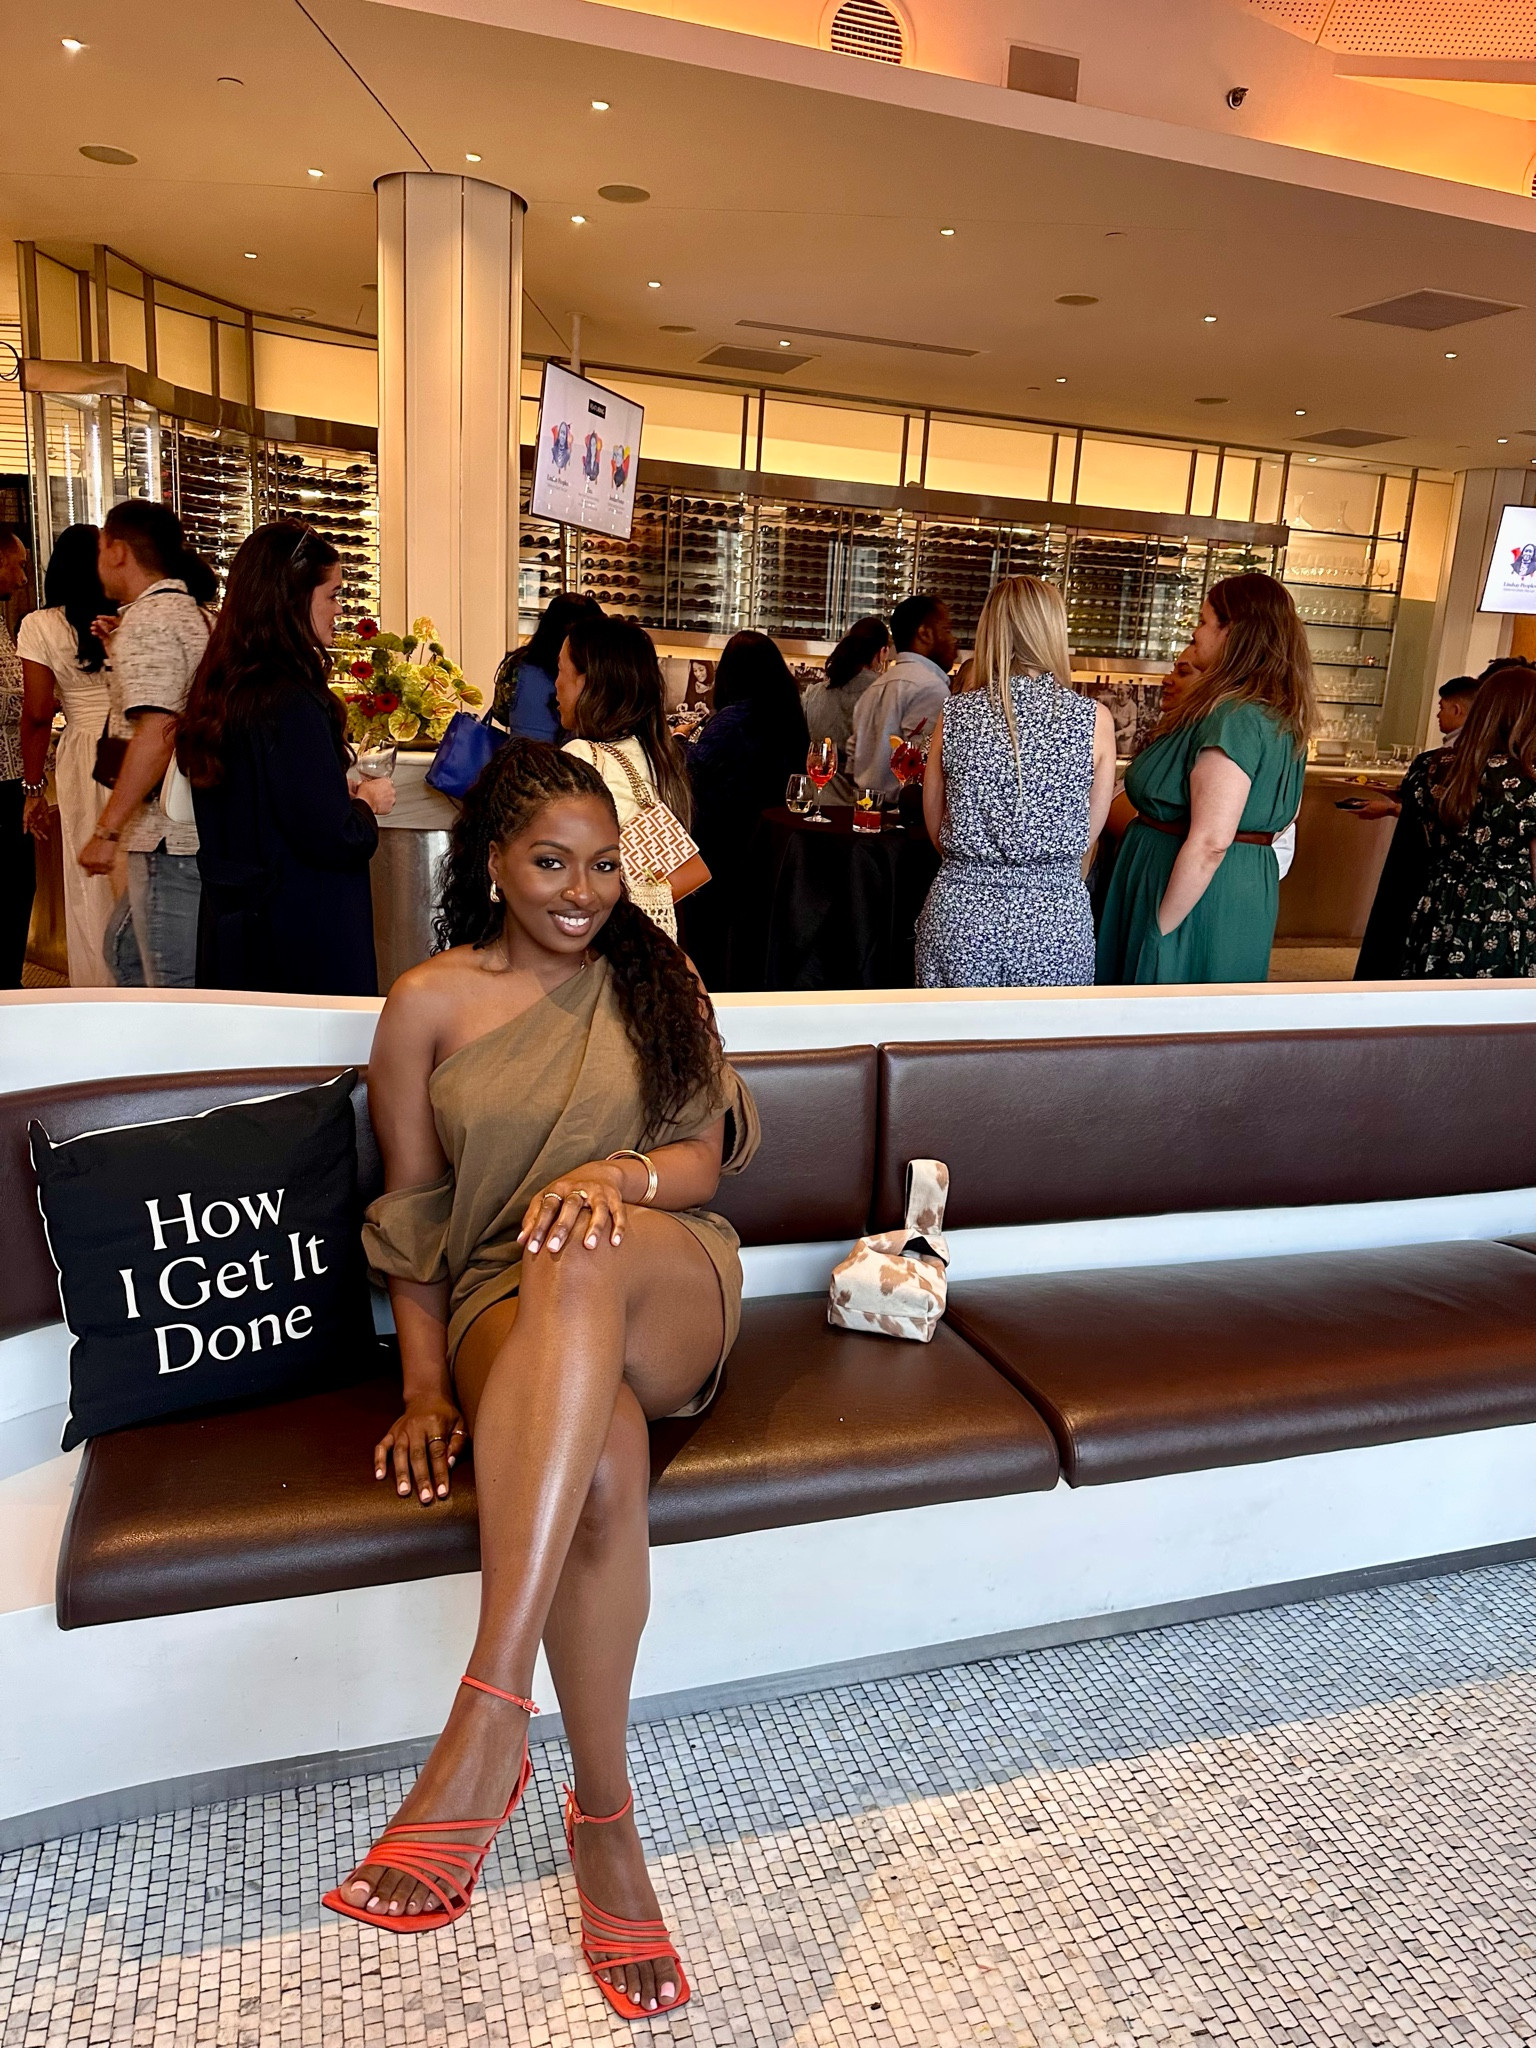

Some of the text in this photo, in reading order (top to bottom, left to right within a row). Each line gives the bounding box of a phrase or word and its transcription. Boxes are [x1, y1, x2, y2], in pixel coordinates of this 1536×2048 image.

[145, 1188, 285, 1251] How
[118, 1231, 329, 1319] I Get It
[154, 1304, 313, 1375] Done
